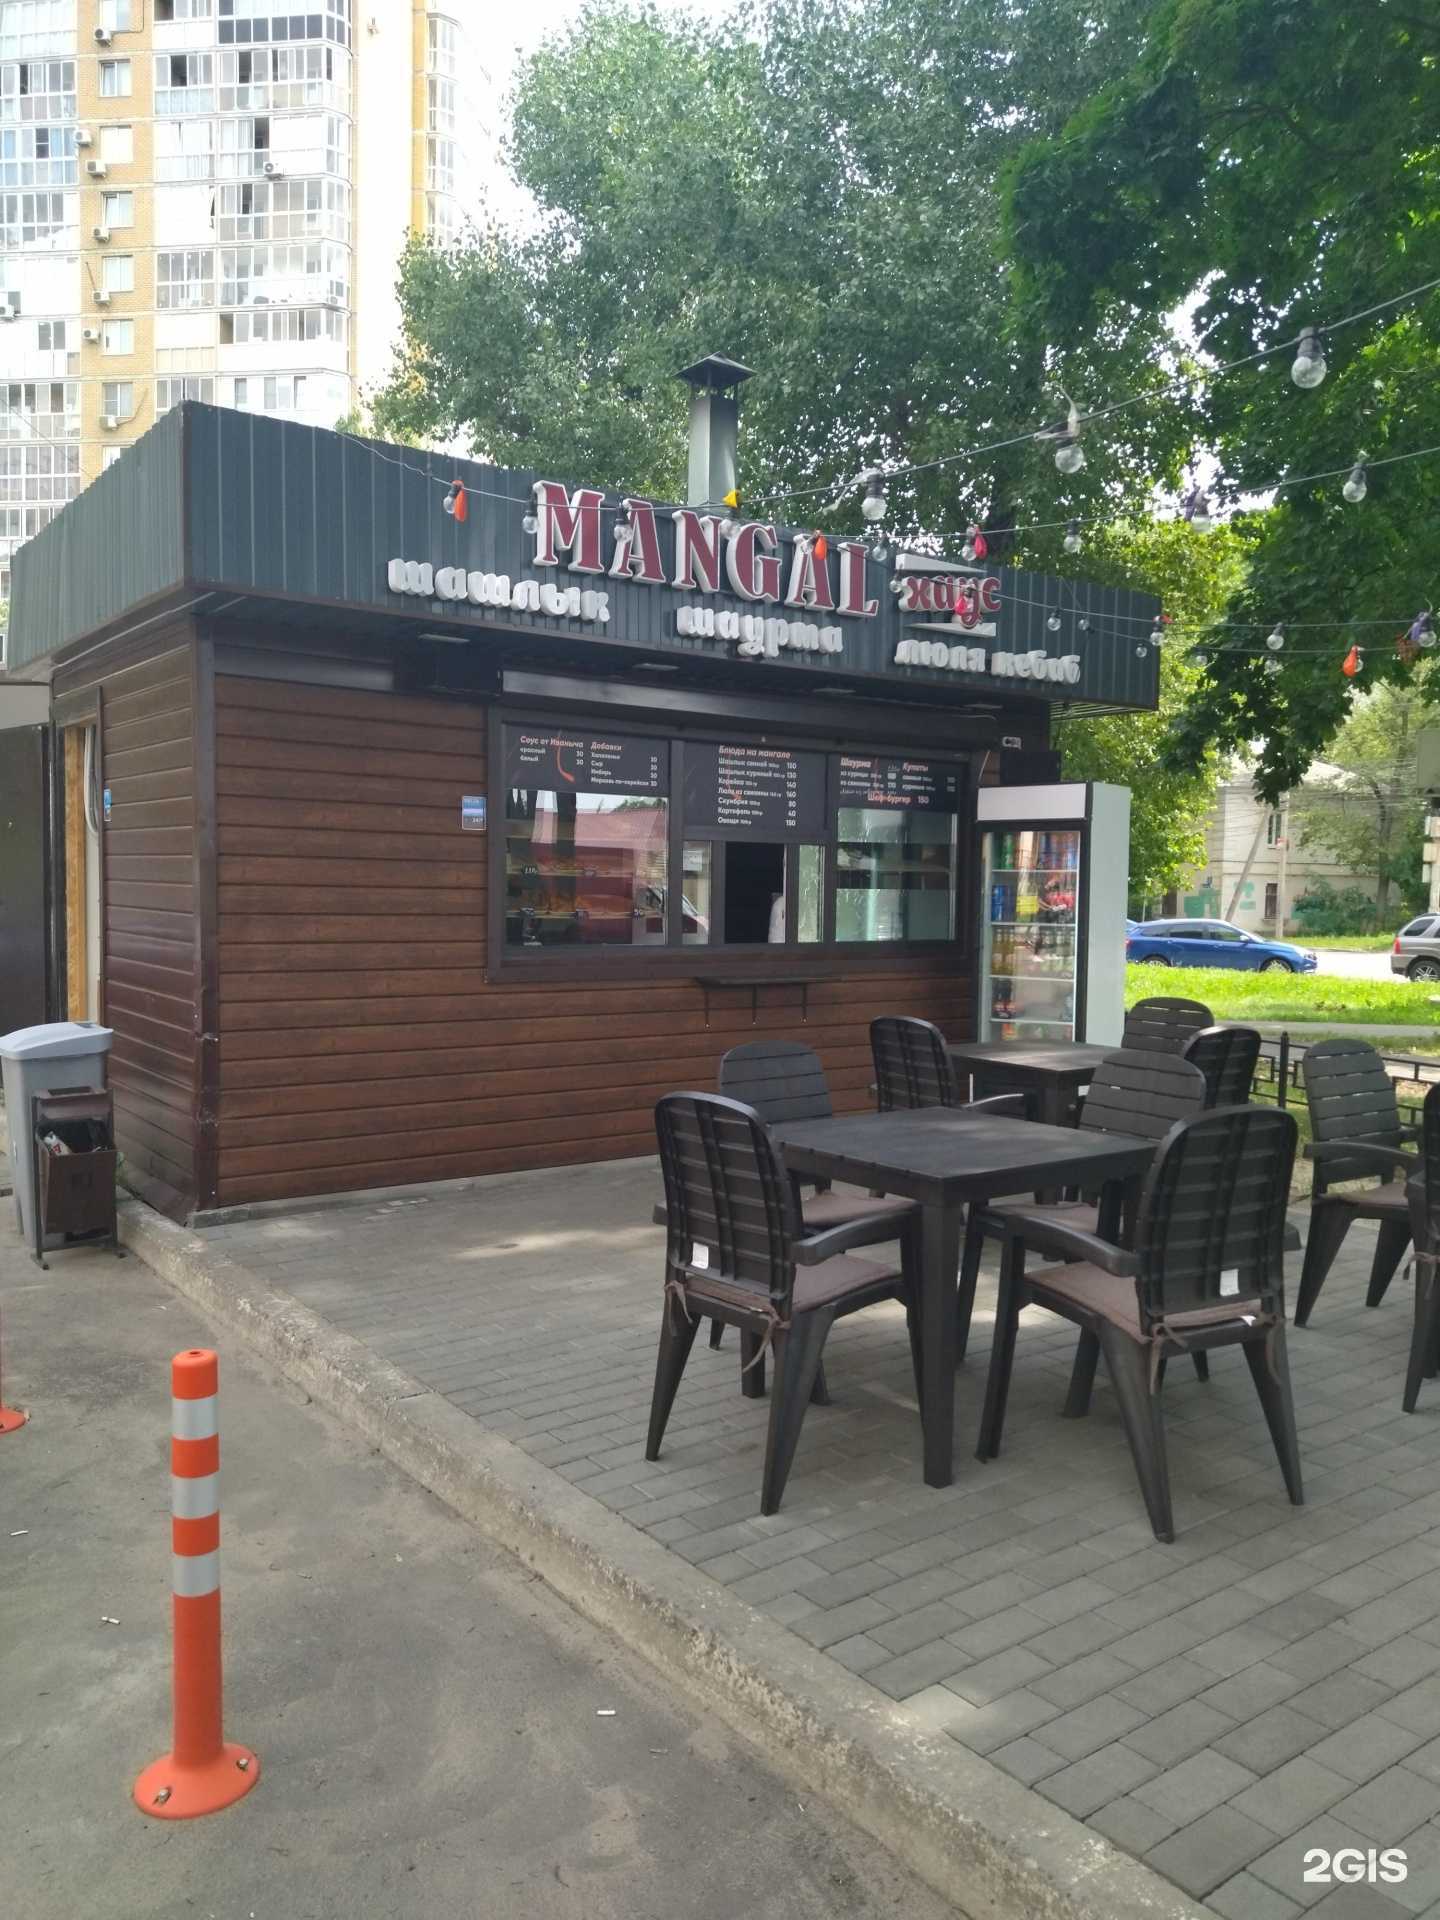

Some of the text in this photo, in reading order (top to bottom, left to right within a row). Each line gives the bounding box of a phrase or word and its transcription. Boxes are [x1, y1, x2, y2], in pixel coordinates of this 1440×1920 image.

[533, 480, 878, 617] MANGAL
[387, 558, 611, 623] шашлык
[676, 605, 844, 658] шаурма
[991, 650, 1081, 684] кебаб
[719, 745, 745, 756] Блюда
[746, 748, 758, 756] на
